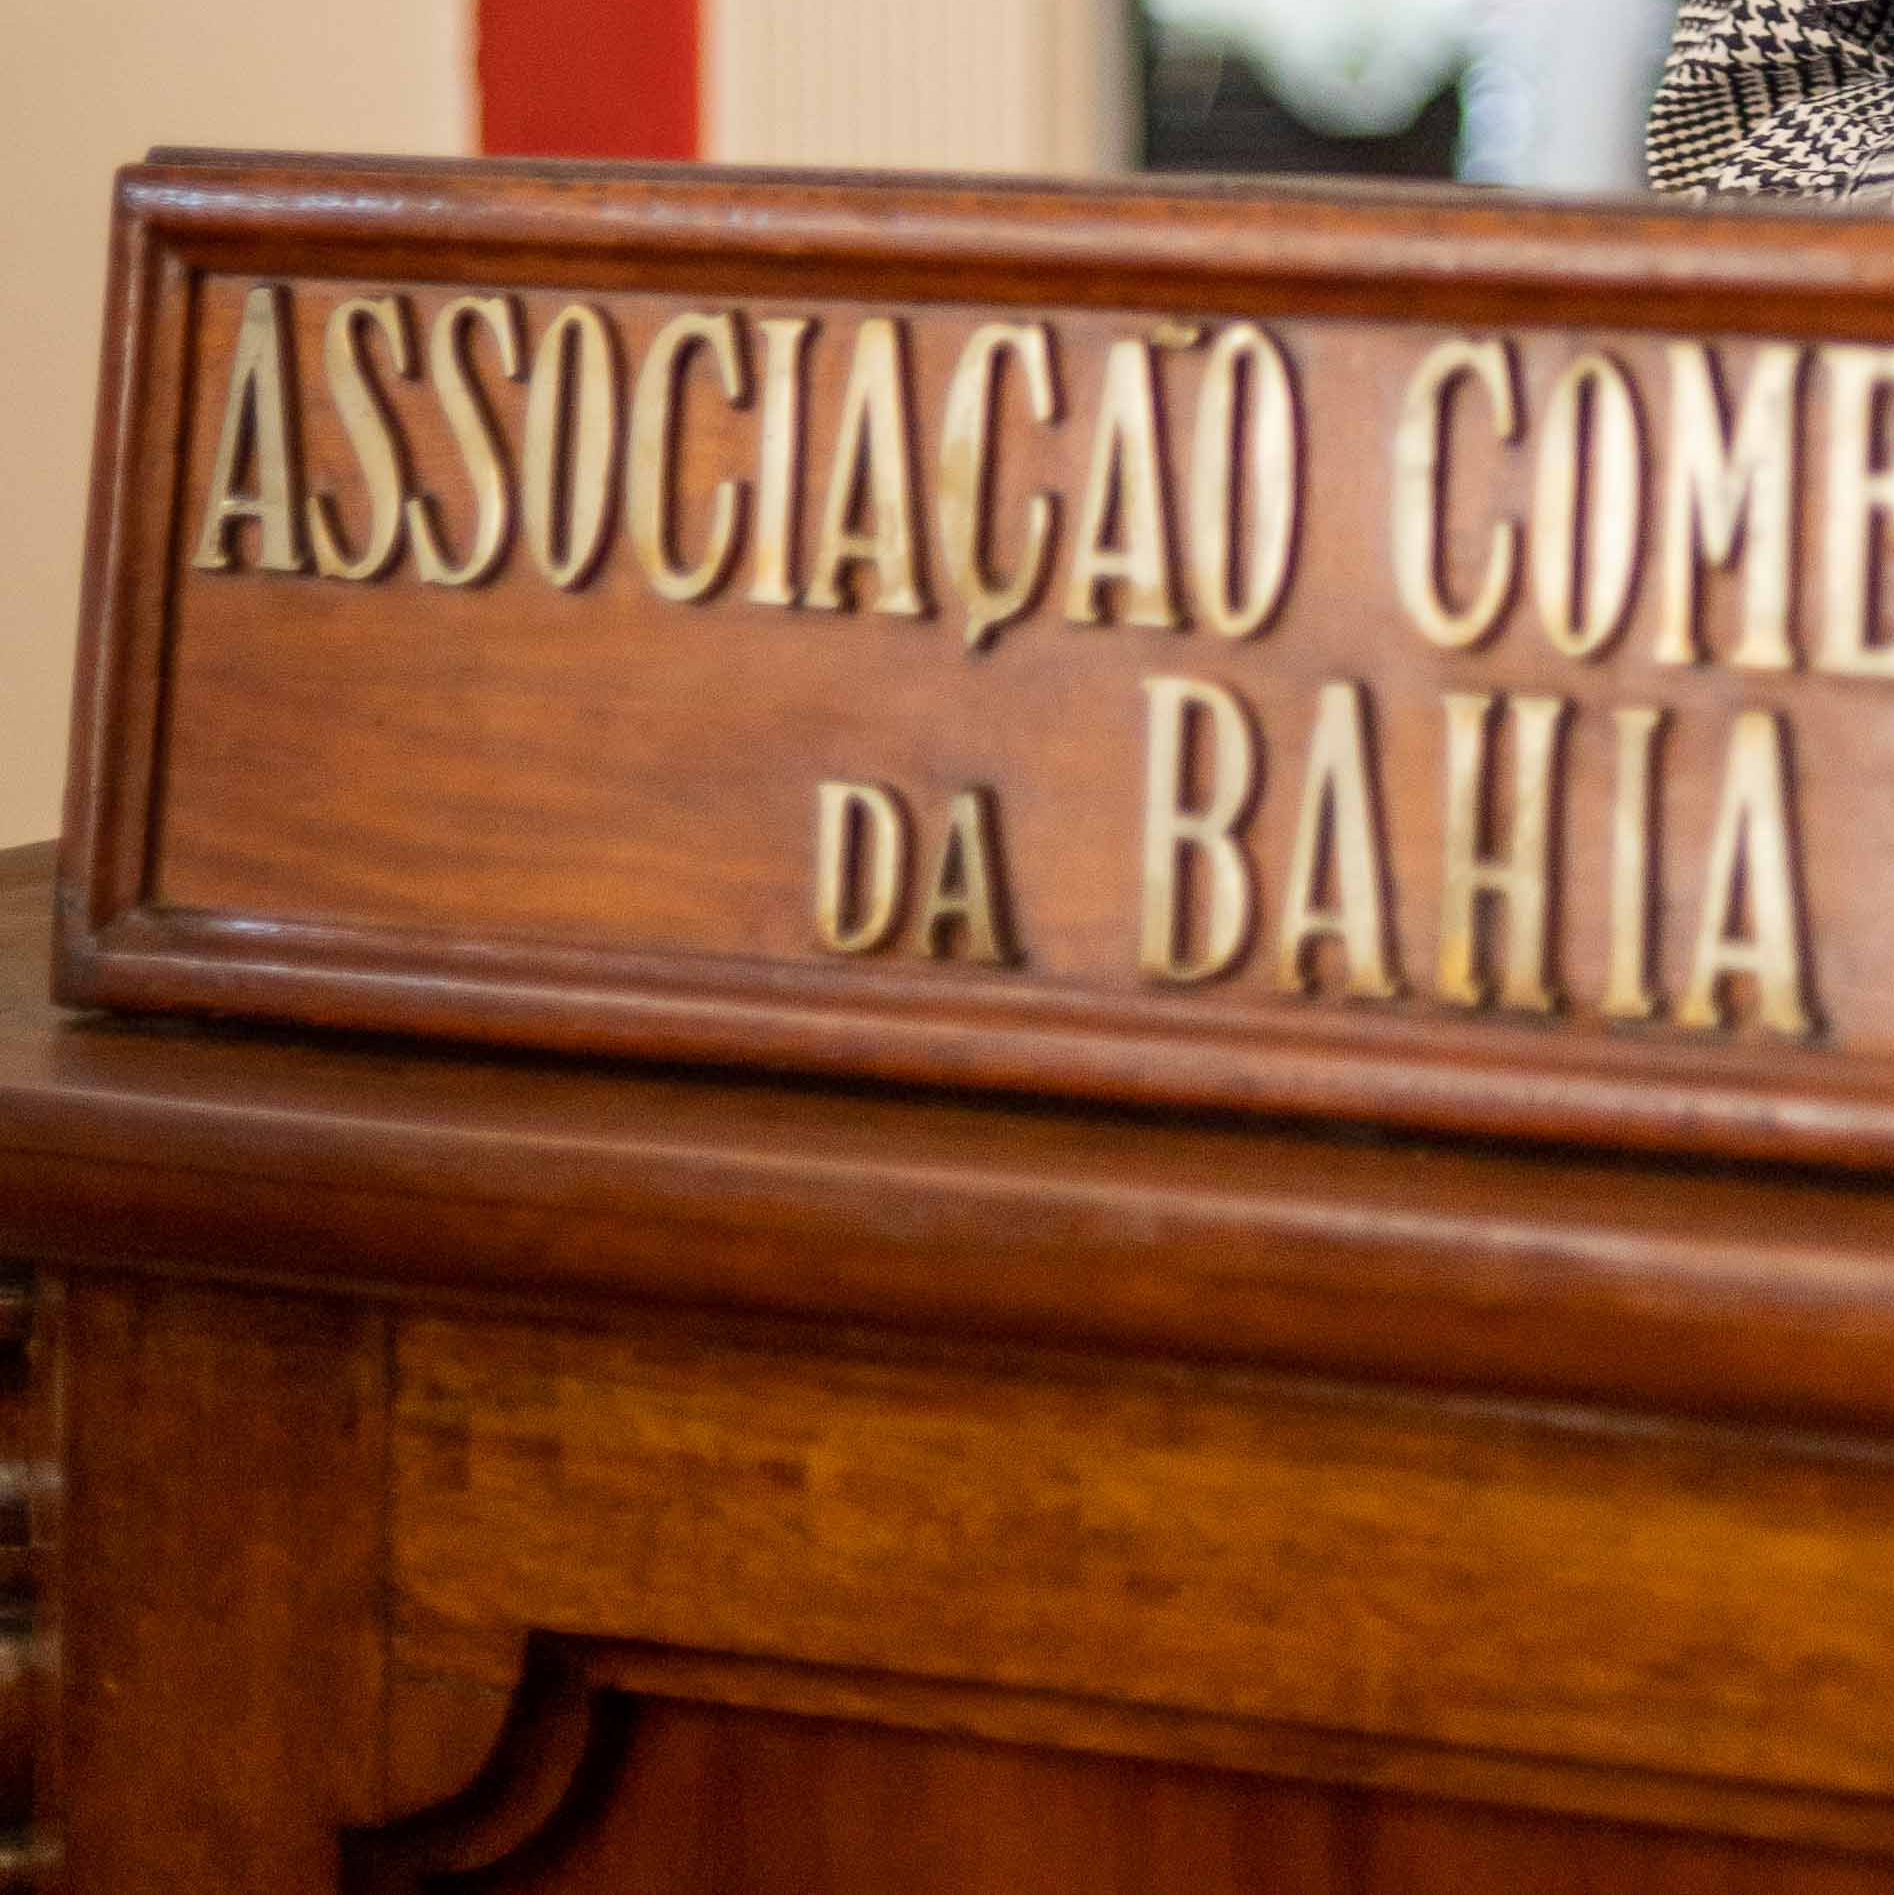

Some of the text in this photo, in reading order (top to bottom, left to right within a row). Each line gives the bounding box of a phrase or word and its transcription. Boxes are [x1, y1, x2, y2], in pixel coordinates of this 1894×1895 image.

[193, 281, 1298, 653] ASSOCIAÇÃO
[818, 675, 1815, 1037] DA BAHIA
